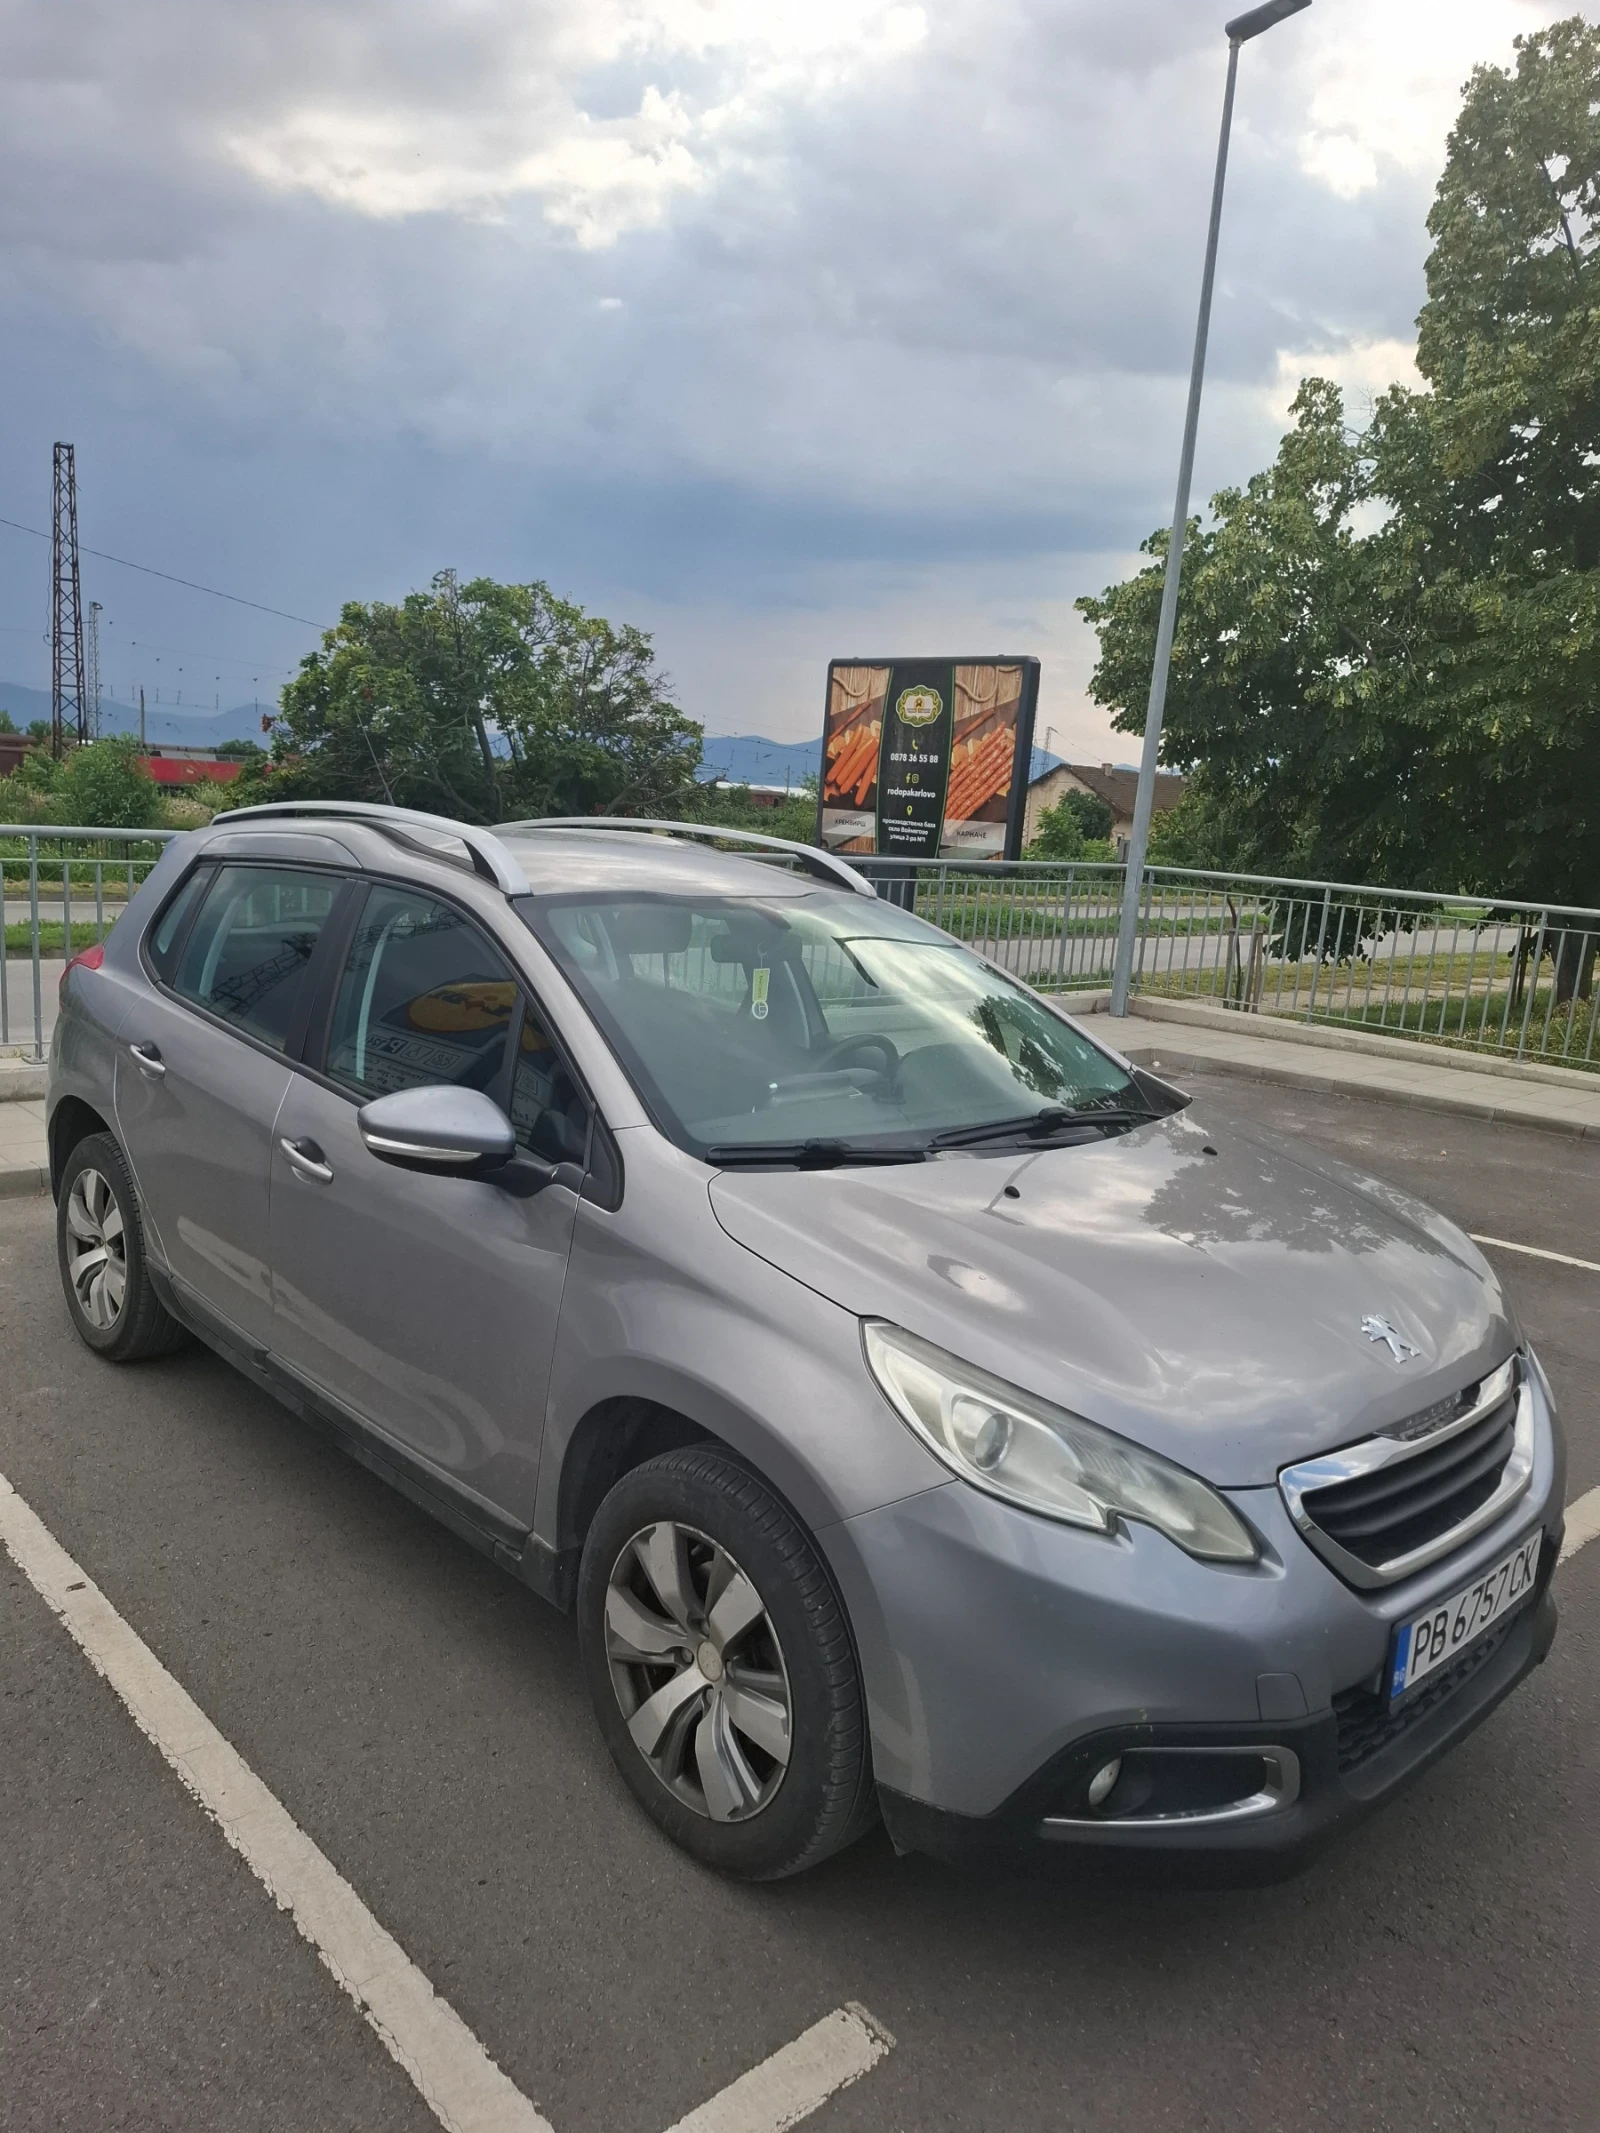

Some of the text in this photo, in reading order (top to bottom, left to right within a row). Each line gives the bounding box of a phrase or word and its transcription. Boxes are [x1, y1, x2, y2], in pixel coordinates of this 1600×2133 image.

[890, 753, 939, 763] 0878 36 55 88
[887, 787, 936, 798] rodopakarlovo
[956, 830, 987, 839] КАРНАЧЕ
[1452, 1562, 1510, 1644] 6757
